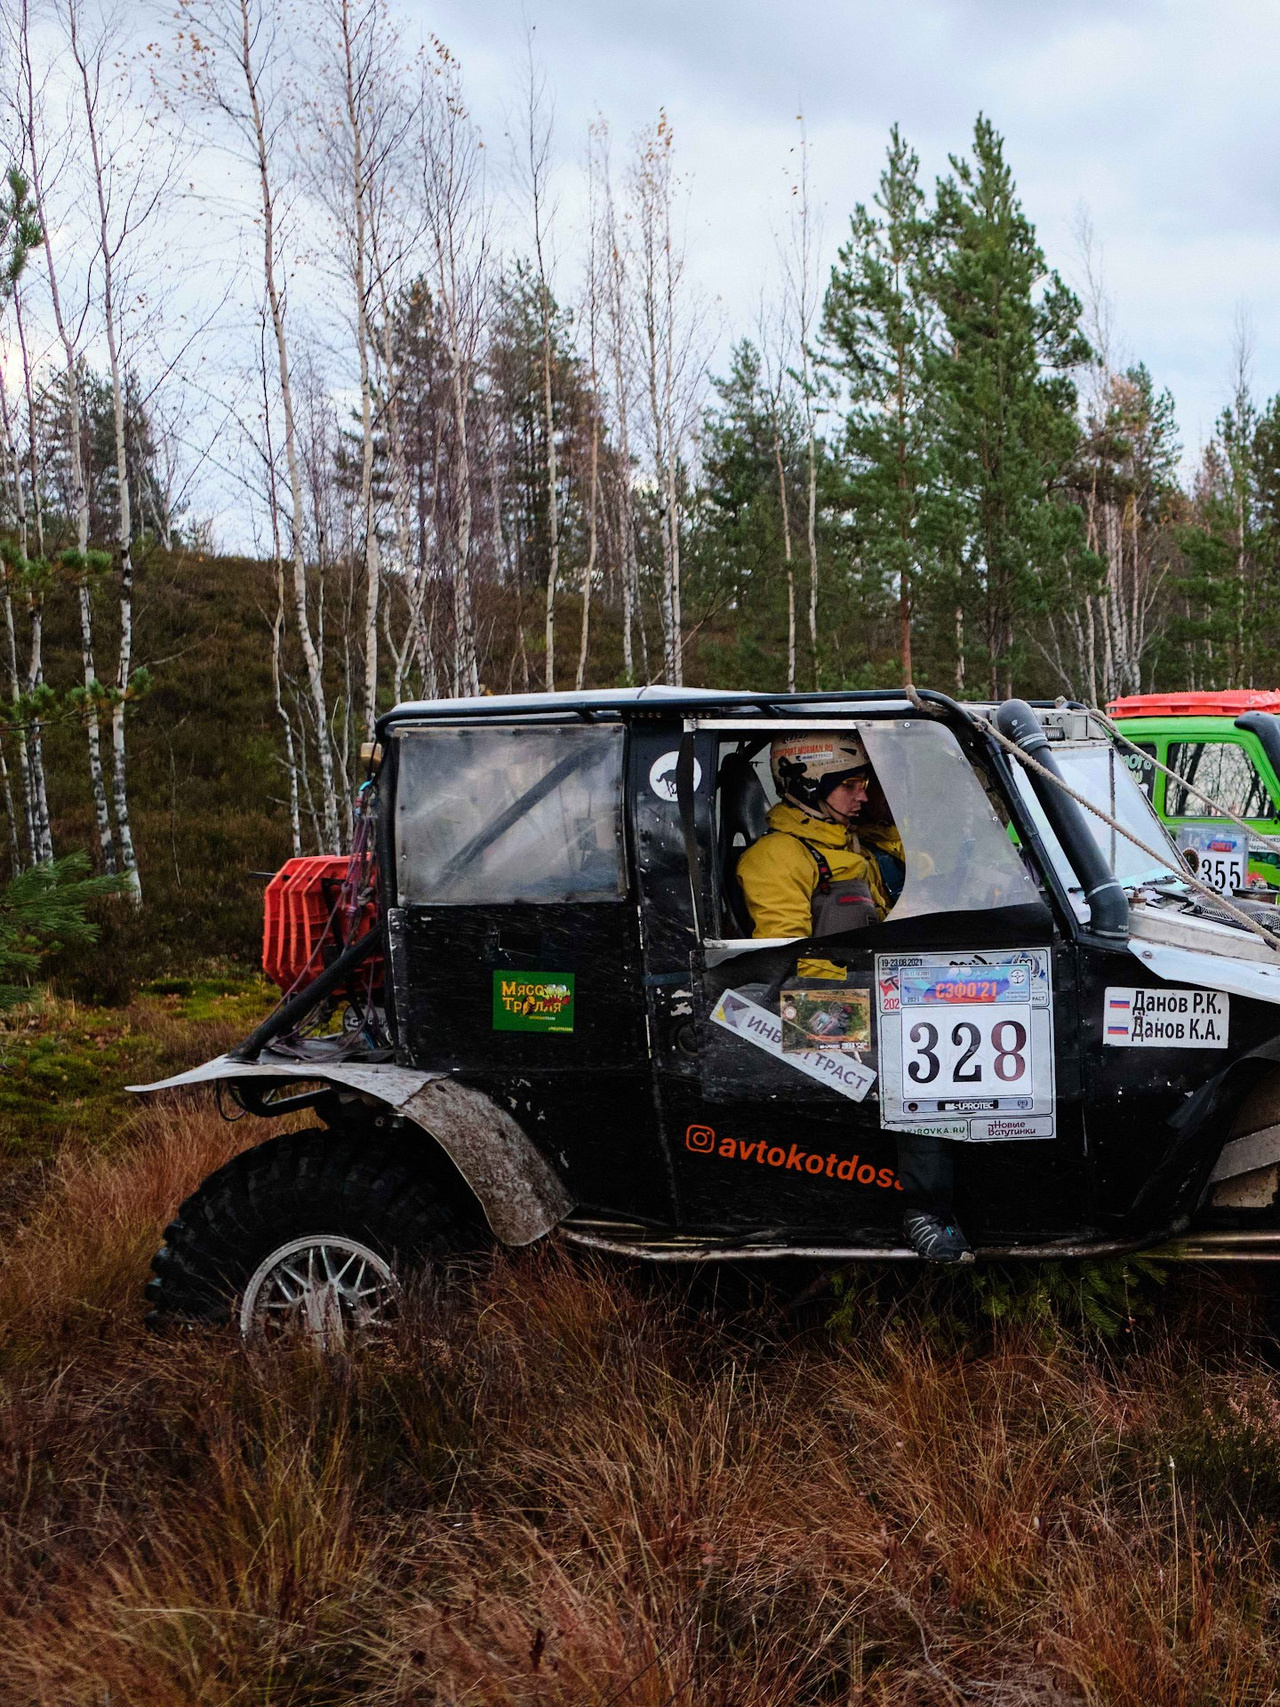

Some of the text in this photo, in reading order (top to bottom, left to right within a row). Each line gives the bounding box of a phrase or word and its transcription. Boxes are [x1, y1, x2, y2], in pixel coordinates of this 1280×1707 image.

[1201, 859, 1241, 889] 355
[881, 957, 923, 967] 19-23.08.2021
[935, 981, 997, 999] СЗФО'21
[502, 997, 562, 1014] Трлля
[883, 998, 900, 1010] 202
[1132, 990, 1222, 1016] Данов Р.К.
[1131, 1016, 1221, 1042] Данов К.А.
[908, 1020, 1027, 1083] 328
[814, 1052, 869, 1090] ТРАСТ
[992, 1121, 1026, 1129] Новые
